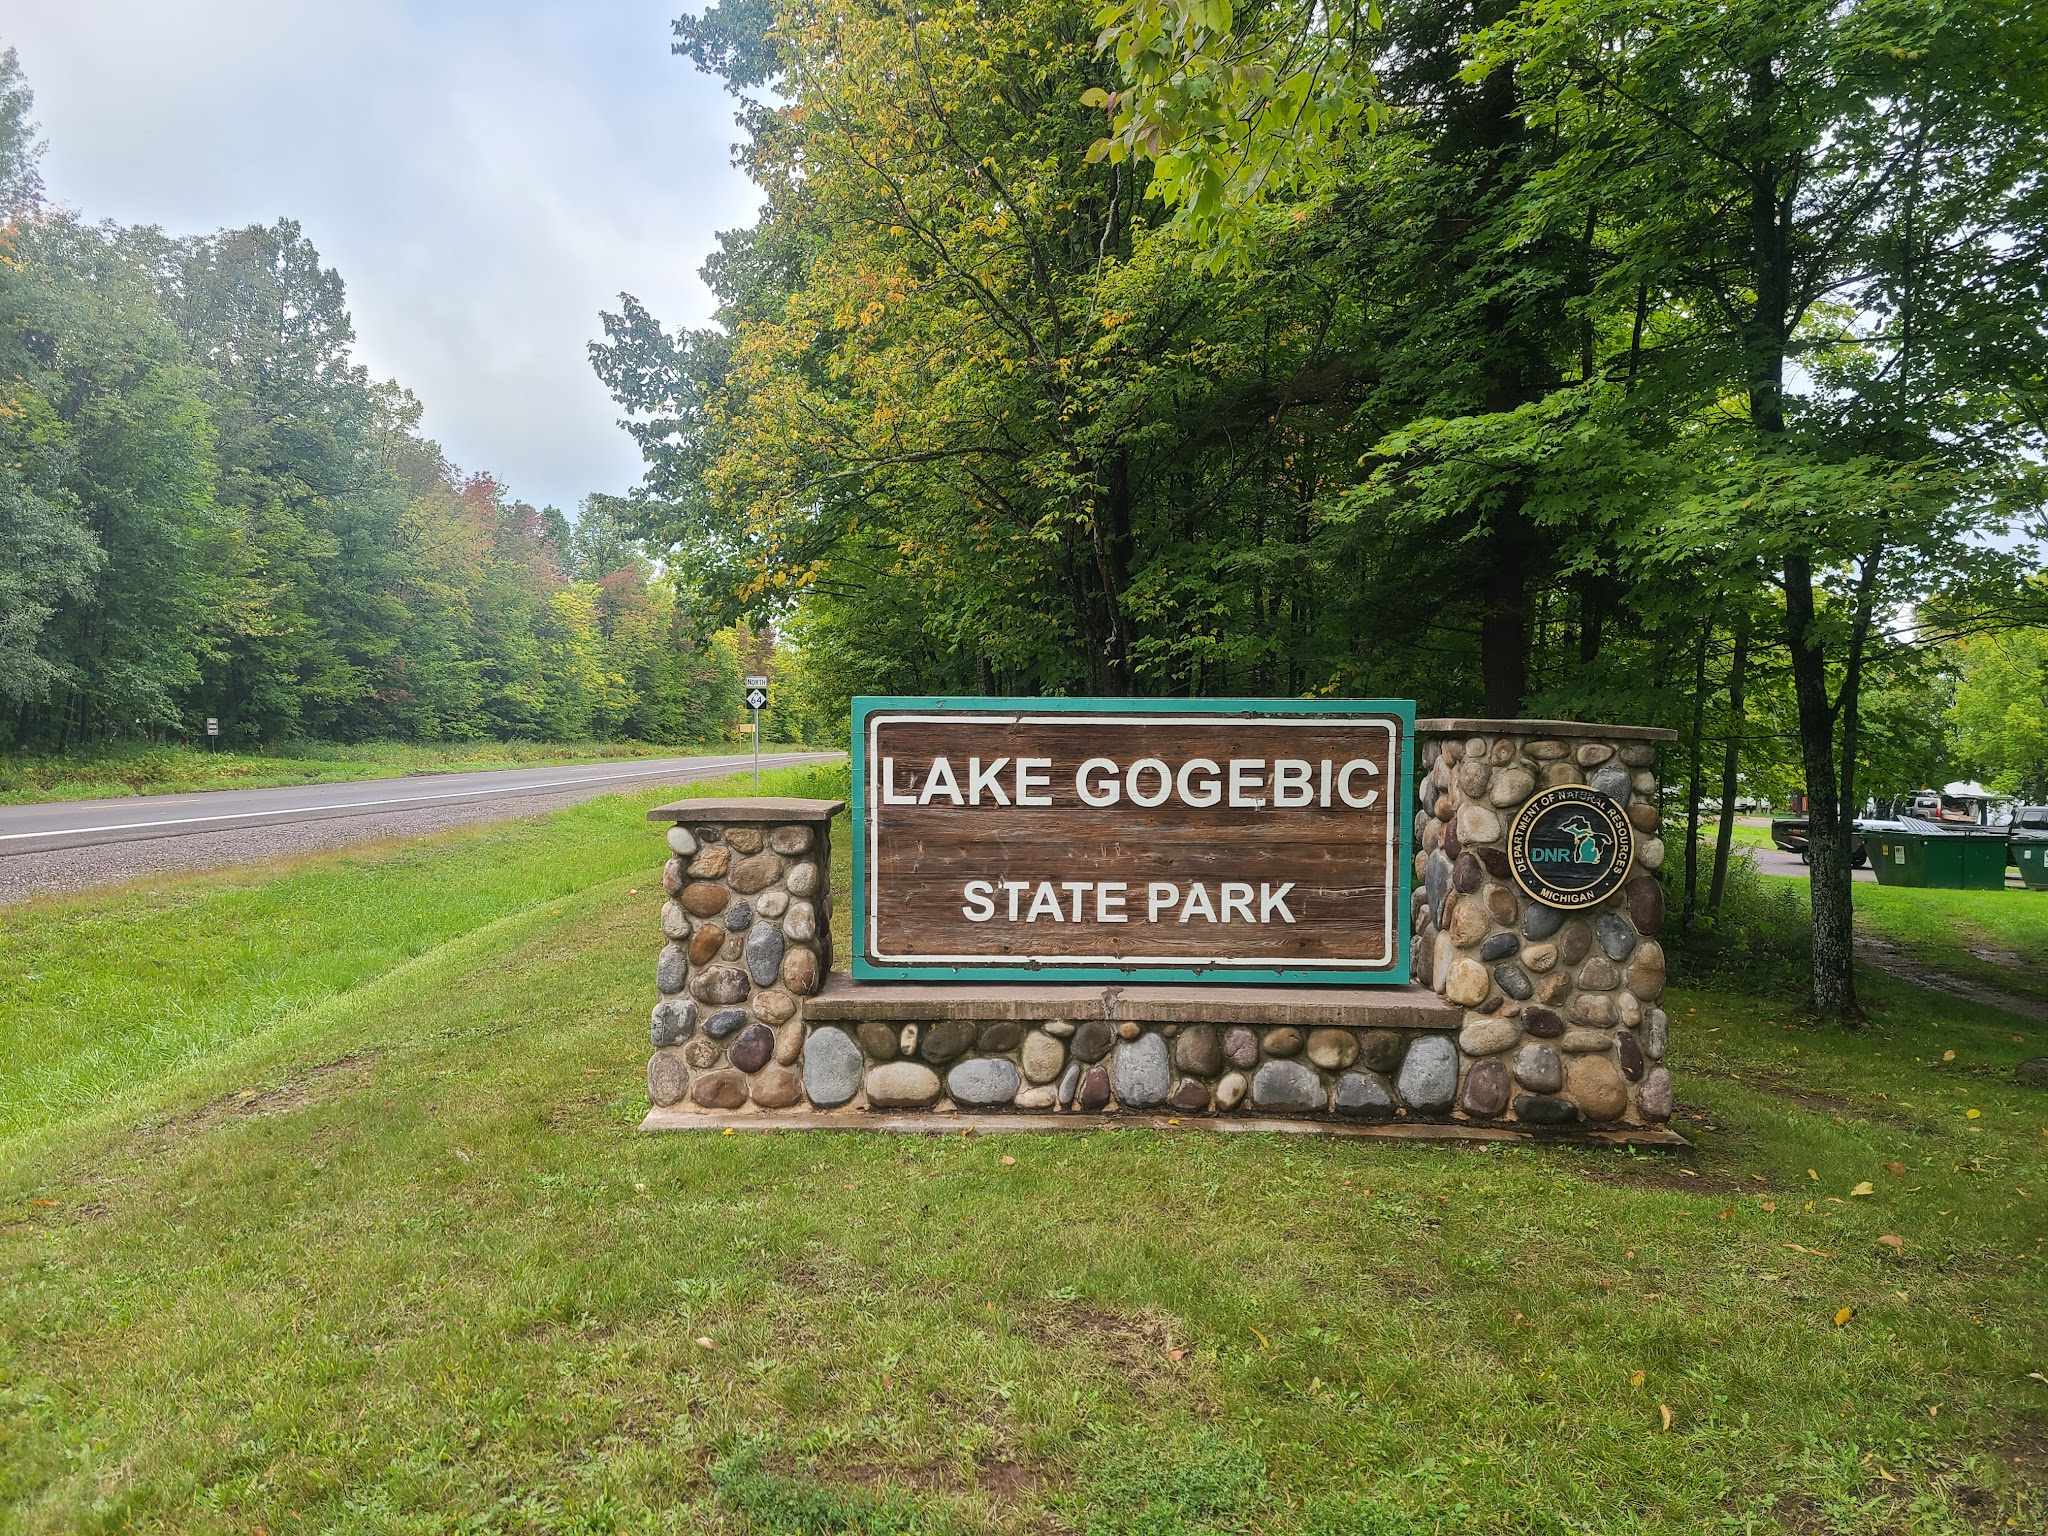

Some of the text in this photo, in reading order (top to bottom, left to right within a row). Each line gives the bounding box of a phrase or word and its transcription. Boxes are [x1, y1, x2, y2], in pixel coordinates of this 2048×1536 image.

[751, 696, 762, 704] 64
[882, 757, 1380, 809] LAKE GOGEBIC
[1513, 790, 1629, 875] DEPARTMENT OF NATURAL RESOURCES
[1531, 847, 1571, 863] DNR
[962, 880, 1296, 924] STATE PARK
[1540, 887, 1595, 903] MICHIGAN
